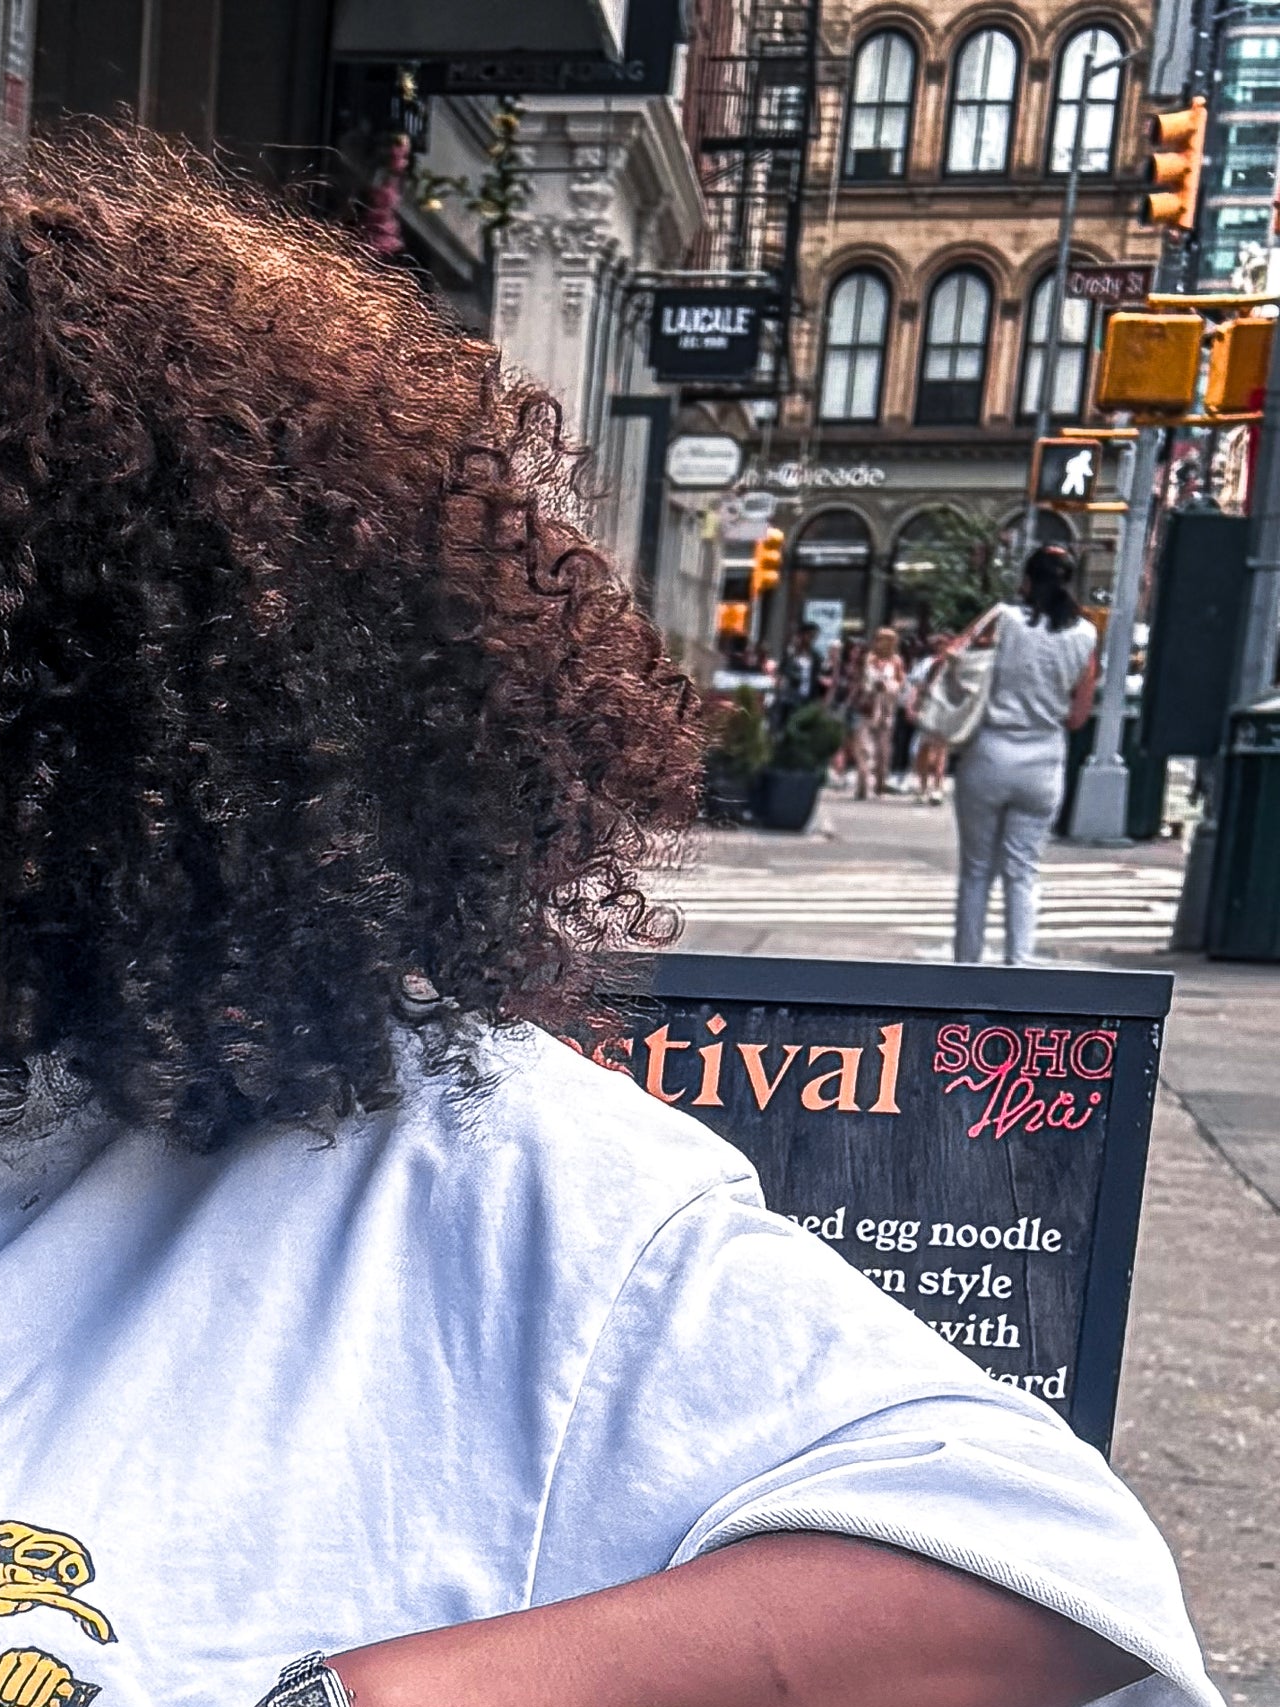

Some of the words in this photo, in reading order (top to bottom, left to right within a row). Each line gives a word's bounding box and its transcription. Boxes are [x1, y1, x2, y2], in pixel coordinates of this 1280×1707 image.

[557, 1013, 906, 1114] tival
[934, 1023, 1118, 1080] SOHO
[786, 1206, 846, 1240] ed
[856, 1217, 921, 1253] egg
[928, 1216, 1062, 1252] noodle
[917, 1264, 1012, 1304] style
[928, 1313, 1021, 1348] with
